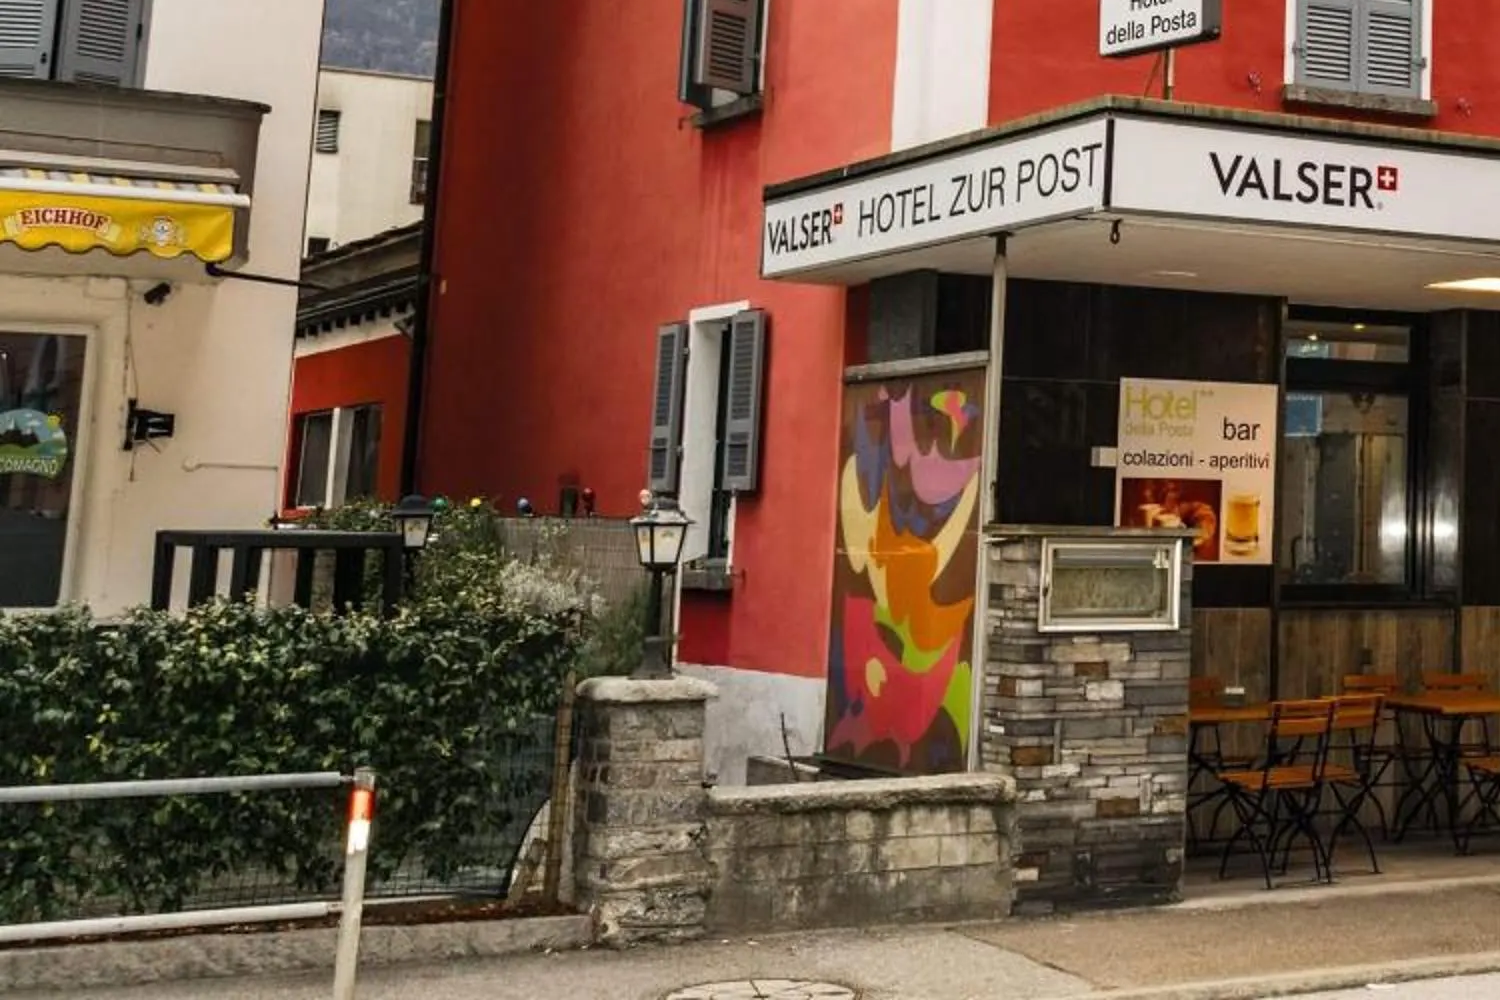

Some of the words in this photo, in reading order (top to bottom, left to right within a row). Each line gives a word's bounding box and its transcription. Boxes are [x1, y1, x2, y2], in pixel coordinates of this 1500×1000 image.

[1106, 21, 1145, 45] della
[1151, 9, 1197, 36] Posta
[1209, 151, 1374, 209] VALSER
[768, 208, 833, 255] VALSER
[858, 184, 940, 237] HOTEL
[949, 167, 1005, 217] ZUR
[1016, 143, 1102, 203] POST
[20, 208, 108, 230] EICHHOF
[1125, 383, 1197, 420] Hotel
[1223, 416, 1260, 440] bar
[1123, 450, 1194, 467] colazioni
[1209, 452, 1271, 470] aperitivi
